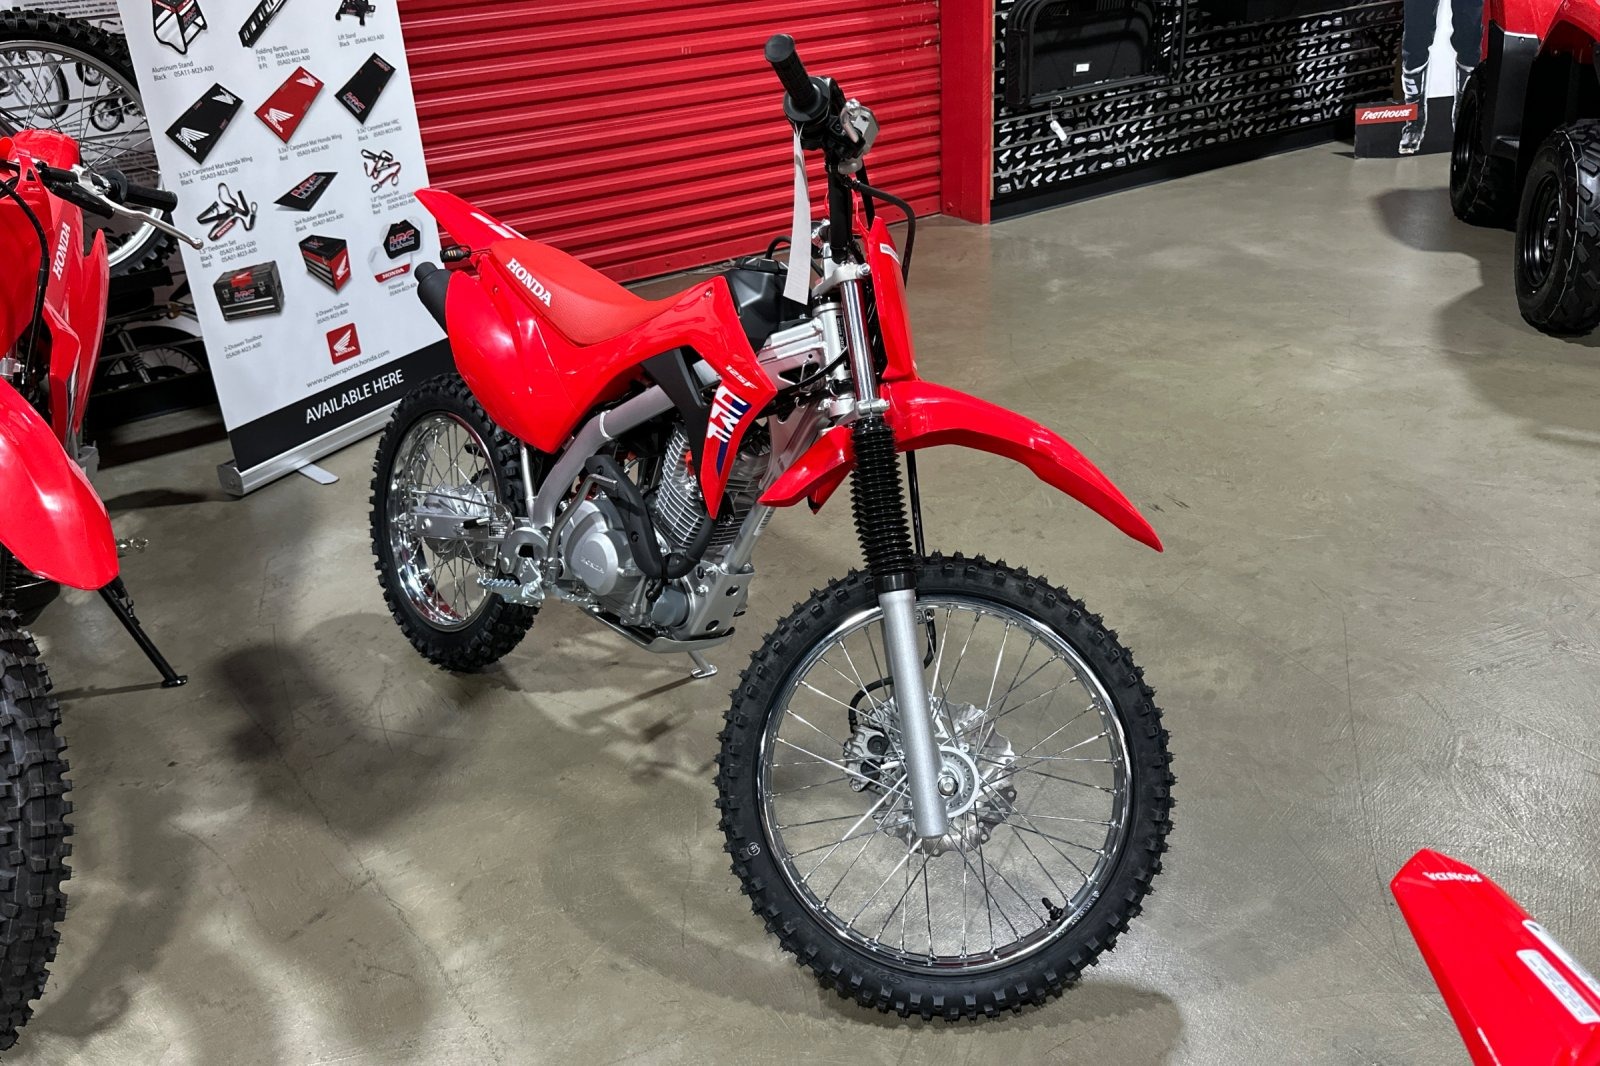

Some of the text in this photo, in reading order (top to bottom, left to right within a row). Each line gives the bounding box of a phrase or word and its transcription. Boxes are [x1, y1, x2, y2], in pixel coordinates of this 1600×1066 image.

[255, 46, 273, 56] Folding
[152, 60, 194, 74] Aluminum Stand
[174, 65, 214, 78] 05A11-M23-A00
[1361, 108, 1412, 120] FASTHOUSE
[176, 133, 196, 153] HONDA
[192, 166, 214, 176] Carpeted
[225, 159, 240, 167] Honda
[52, 222, 71, 280] HONDA
[200, 254, 213, 262] Black
[382, 268, 405, 279] HONDA
[506, 258, 552, 307] HONDA
[244, 334, 262, 344] Toolbox
[306, 349, 390, 389] www.powersports.honda.com
[725, 364, 758, 390] 125F
[306, 369, 404, 424] AVAILABLE HERE
[1422, 871, 1483, 883] HONDA
